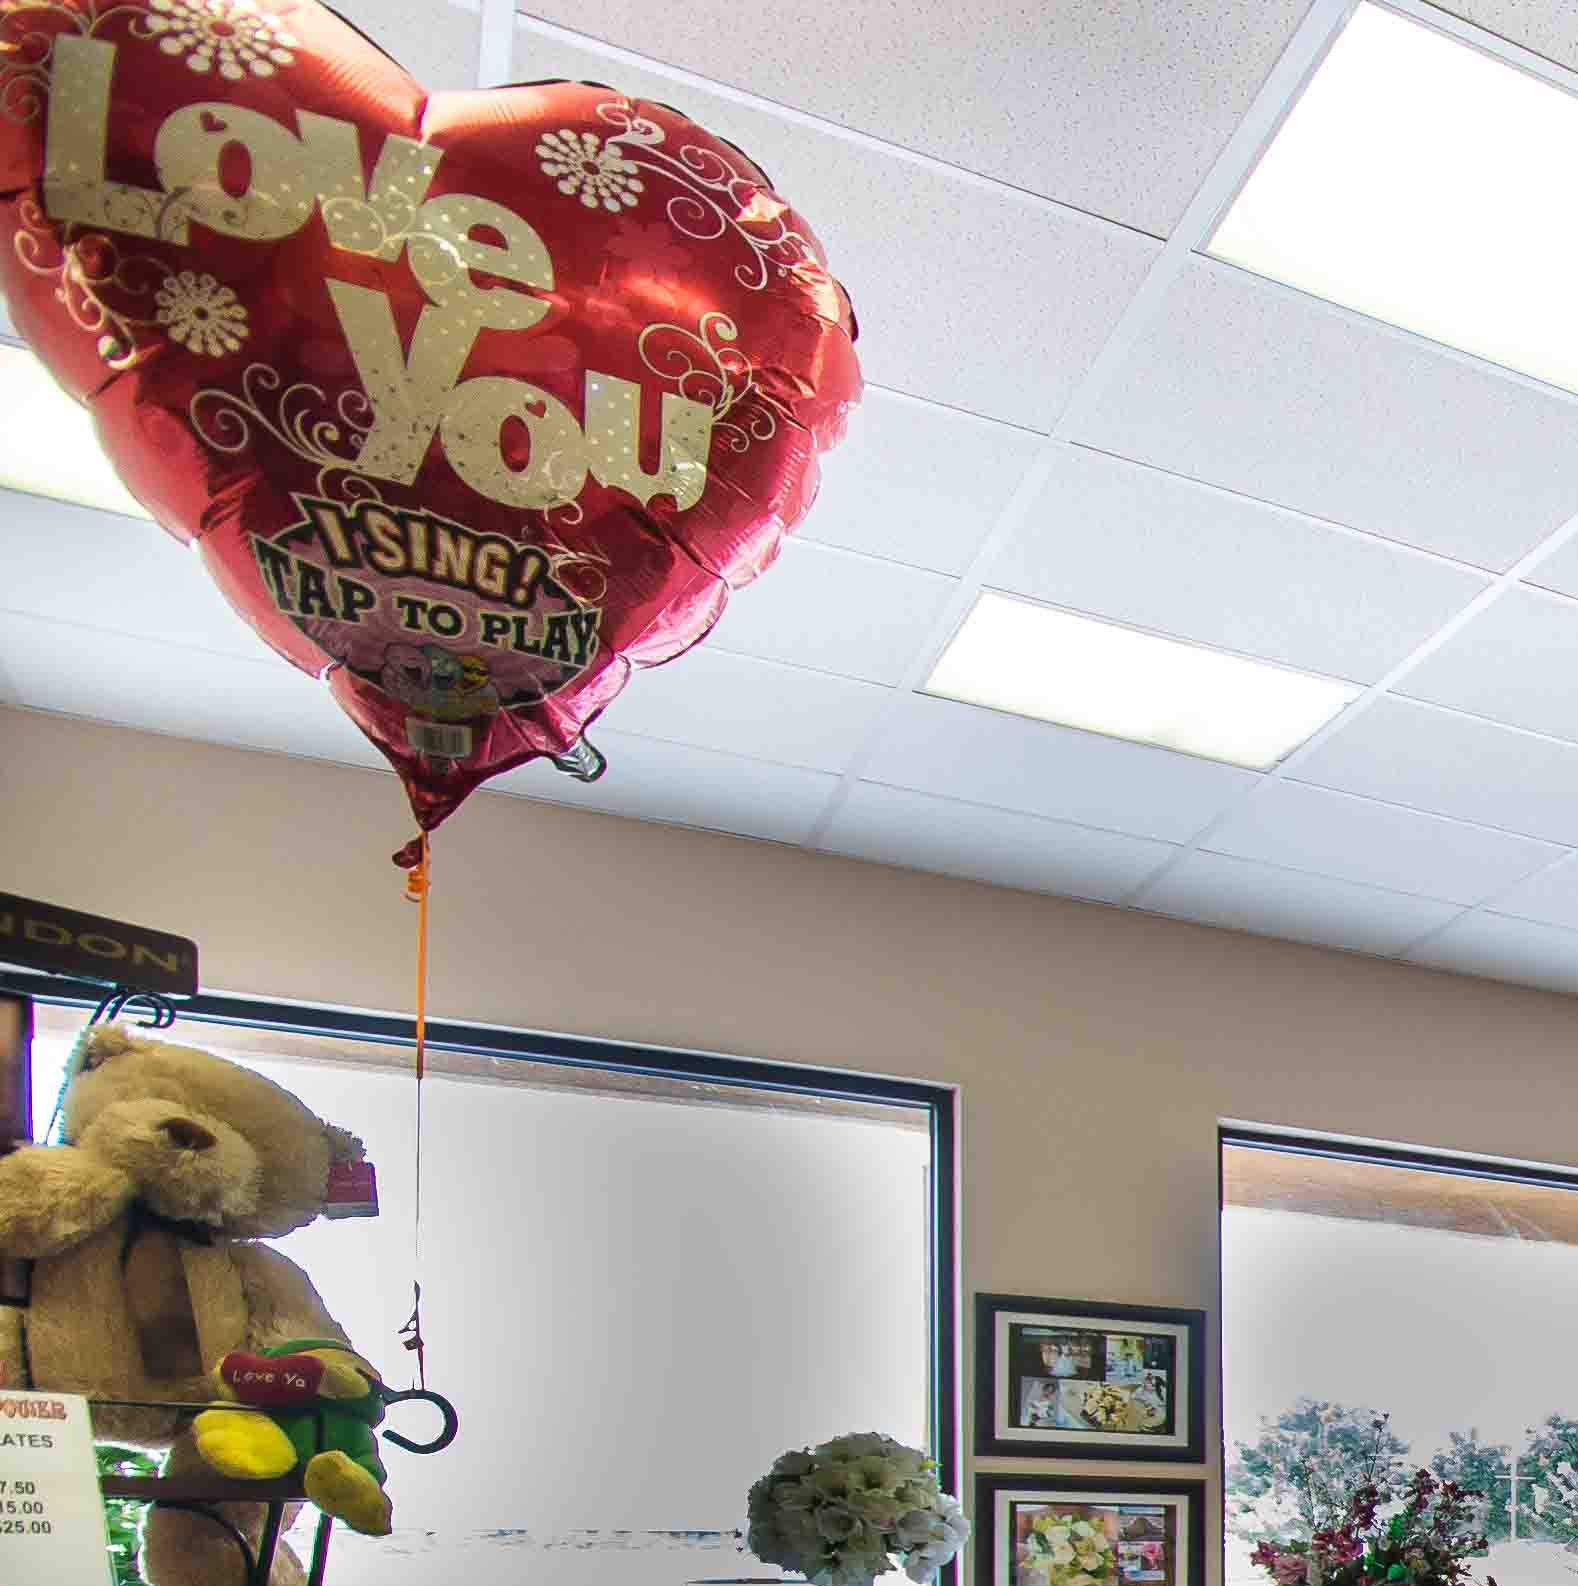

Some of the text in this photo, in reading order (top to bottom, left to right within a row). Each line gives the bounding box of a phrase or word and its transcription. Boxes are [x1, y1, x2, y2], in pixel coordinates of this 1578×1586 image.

[43, 32, 556, 334] Love
[327, 276, 714, 513] You
[300, 500, 551, 605] I SING!
[254, 545, 600, 668] TAP TO PLAY
[0, 912, 178, 976] DON
[232, 1369, 306, 1388] Love Ya
[0, 1433, 54, 1449] ATES
